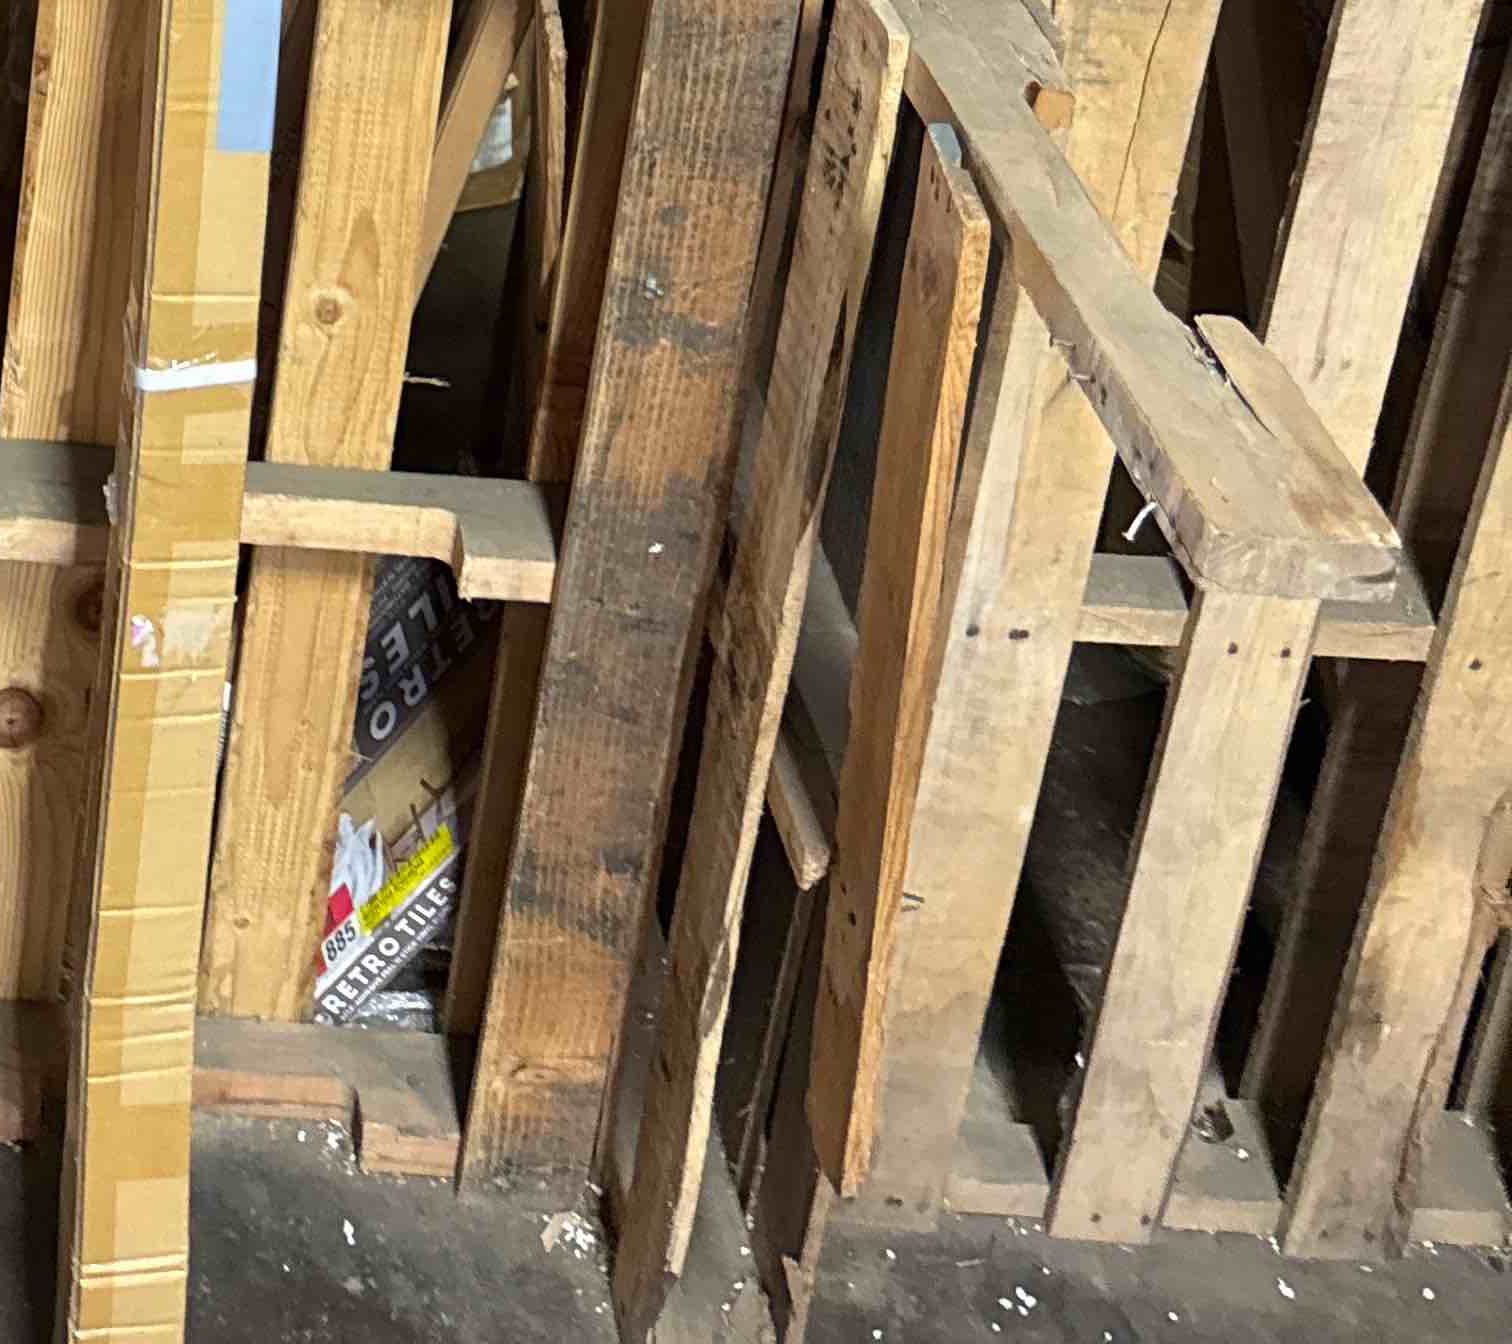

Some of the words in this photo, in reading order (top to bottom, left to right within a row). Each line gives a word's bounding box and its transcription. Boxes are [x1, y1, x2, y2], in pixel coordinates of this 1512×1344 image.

[321, 936, 401, 1014] RETRO
[394, 877, 457, 937] TILES
[325, 920, 357, 962] 885
